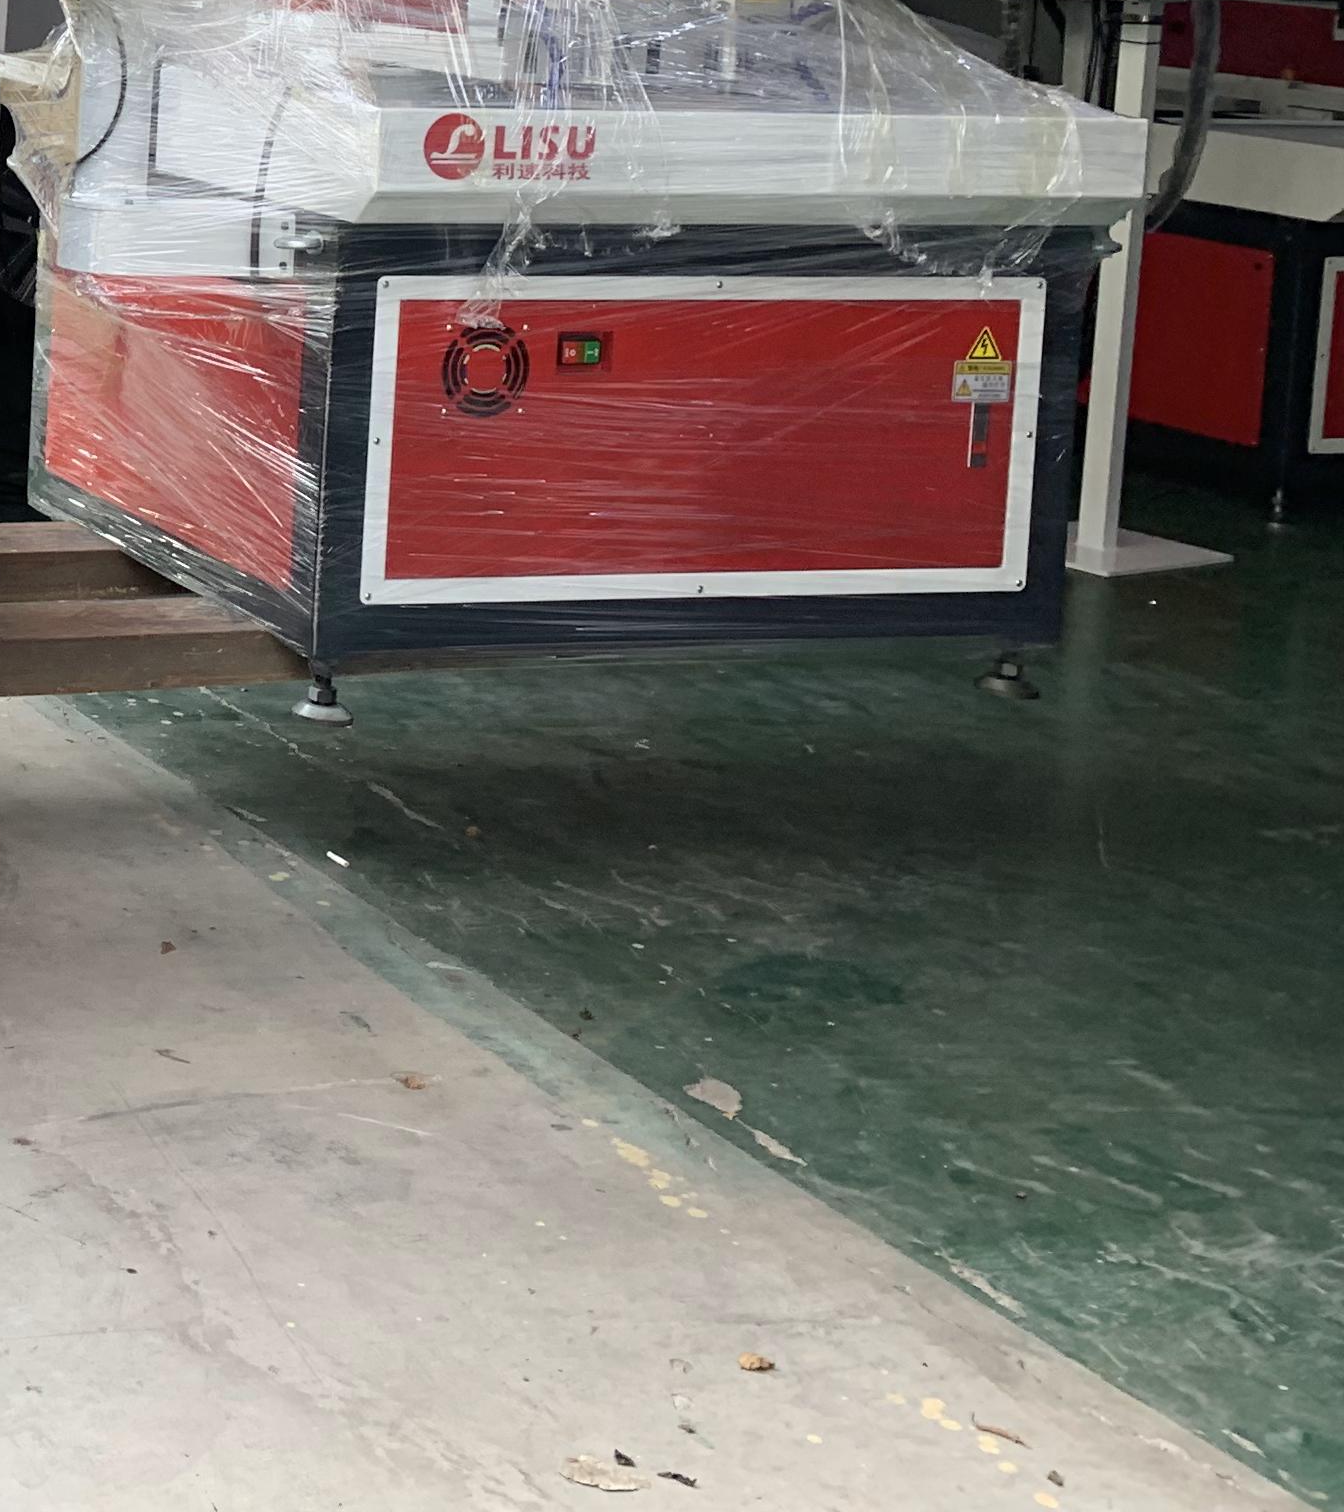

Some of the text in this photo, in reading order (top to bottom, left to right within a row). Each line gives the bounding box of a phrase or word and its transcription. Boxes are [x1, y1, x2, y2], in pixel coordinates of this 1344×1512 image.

[493, 125, 597, 161] LISU
[492, 163, 591, 180] 利速科技
